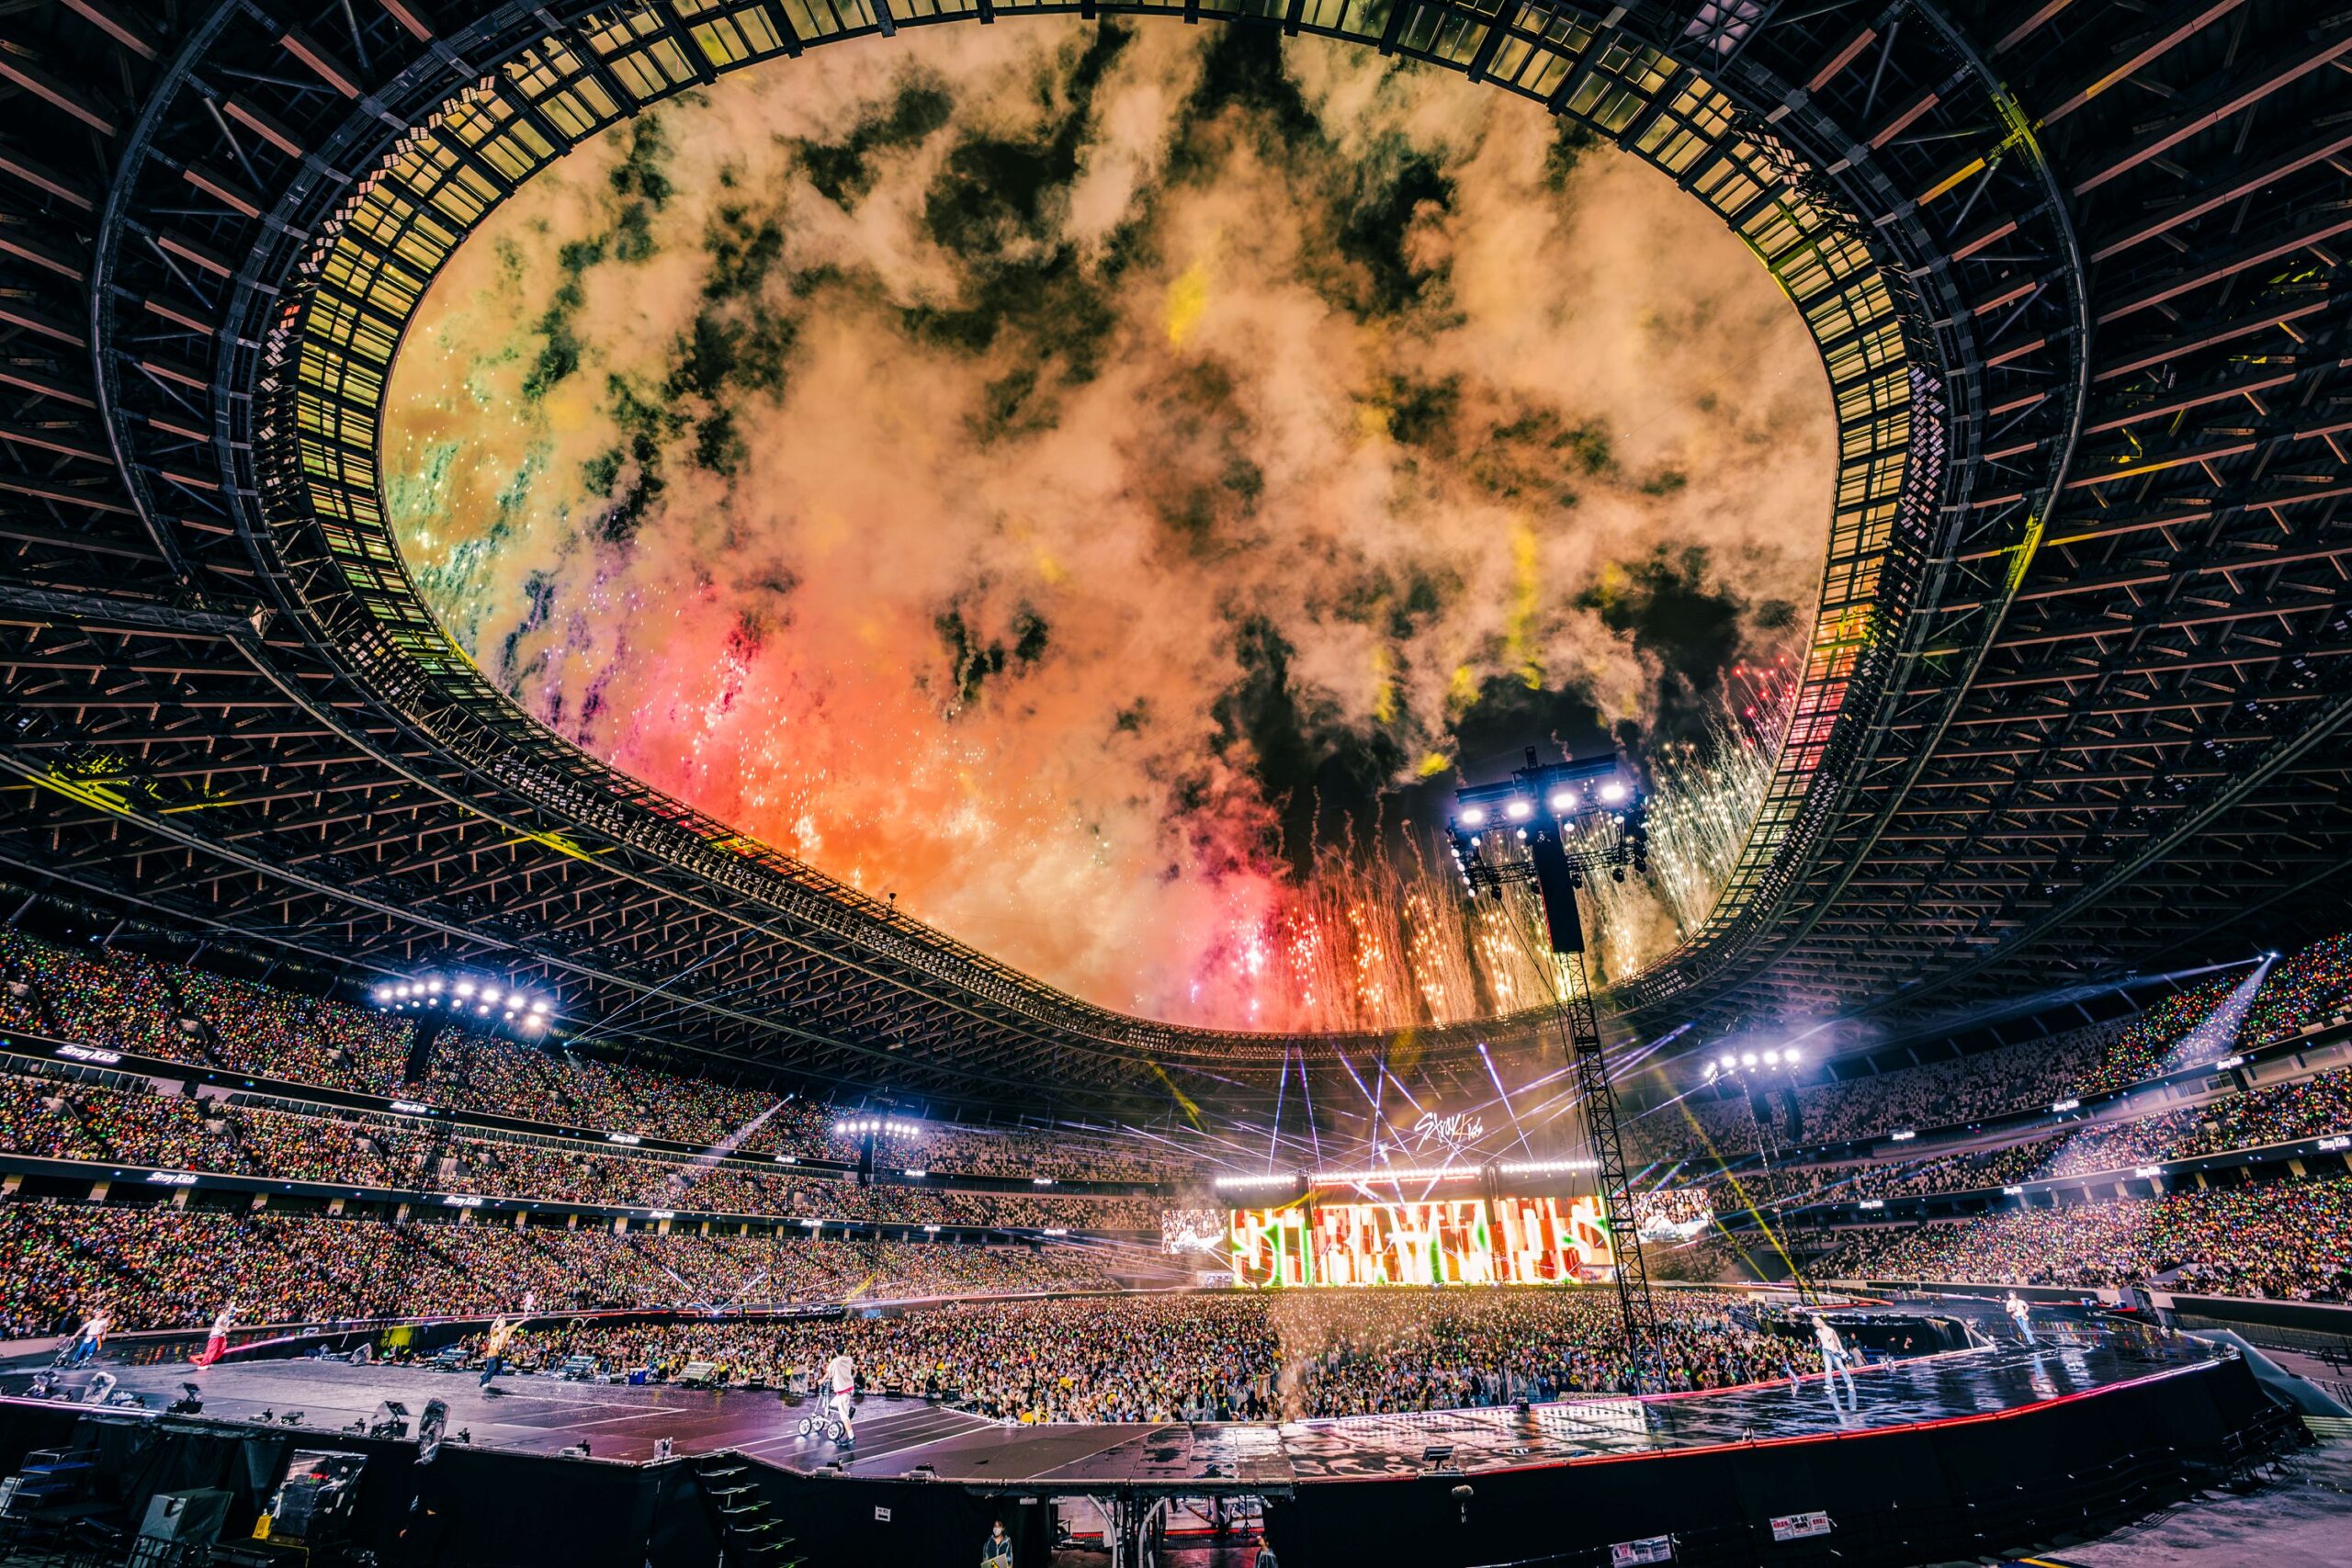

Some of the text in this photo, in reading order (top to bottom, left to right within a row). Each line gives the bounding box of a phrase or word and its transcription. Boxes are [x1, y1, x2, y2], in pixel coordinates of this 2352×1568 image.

[55, 1044, 122, 1064] Stray Kids
[1414, 1112, 1461, 1151] Stray
[146, 1172, 198, 1184] Stray Kids
